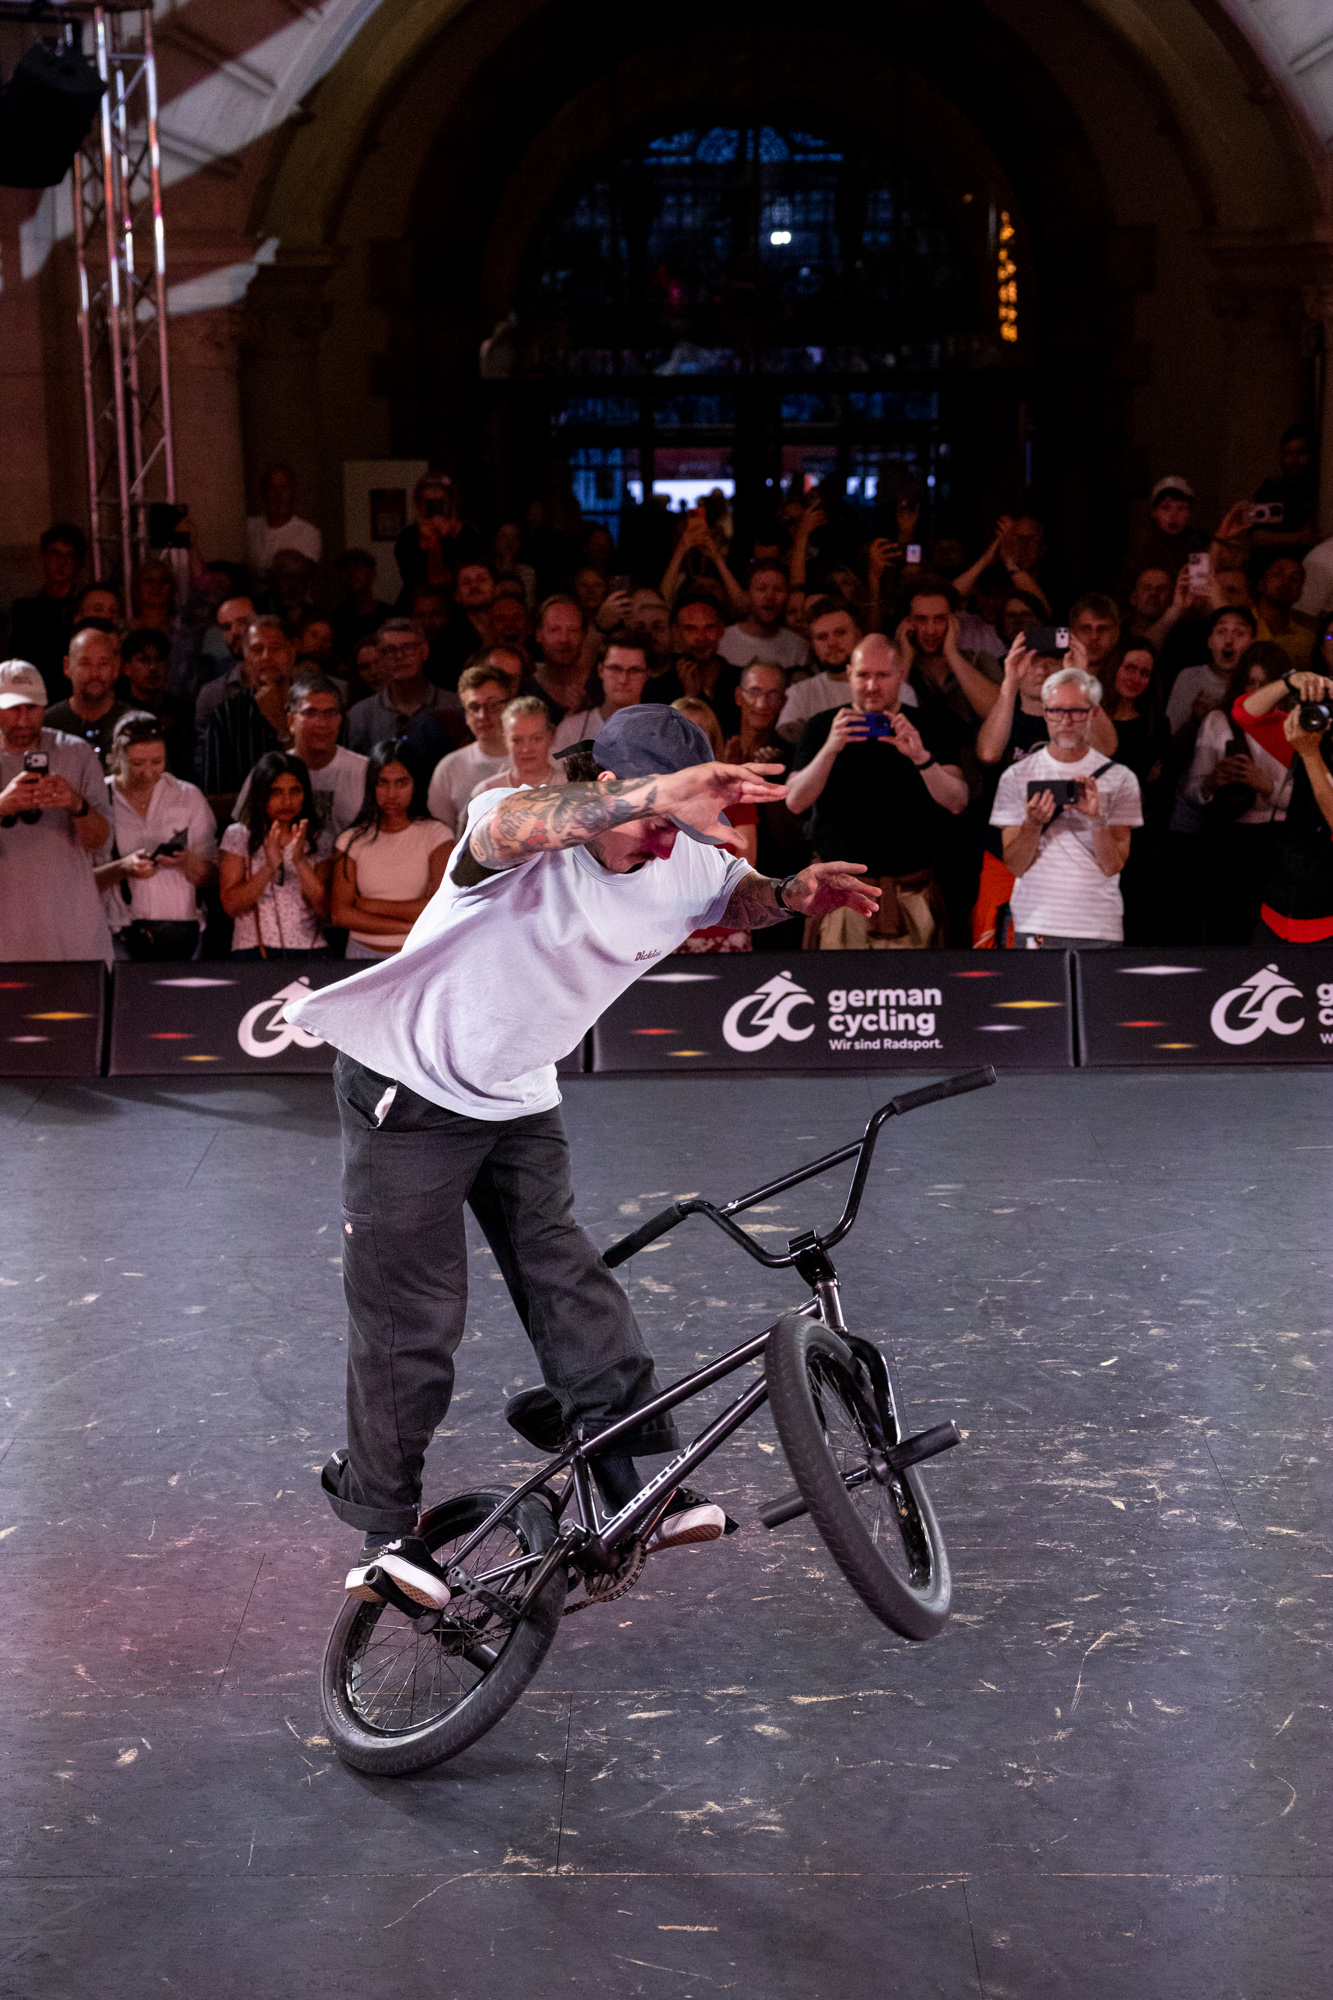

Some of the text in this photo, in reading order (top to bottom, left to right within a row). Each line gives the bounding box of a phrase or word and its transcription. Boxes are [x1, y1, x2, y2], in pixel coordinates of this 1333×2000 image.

[827, 988, 942, 1013] german
[827, 1009, 936, 1038] cycling
[829, 1038, 944, 1052] Wir sind Radsport.
